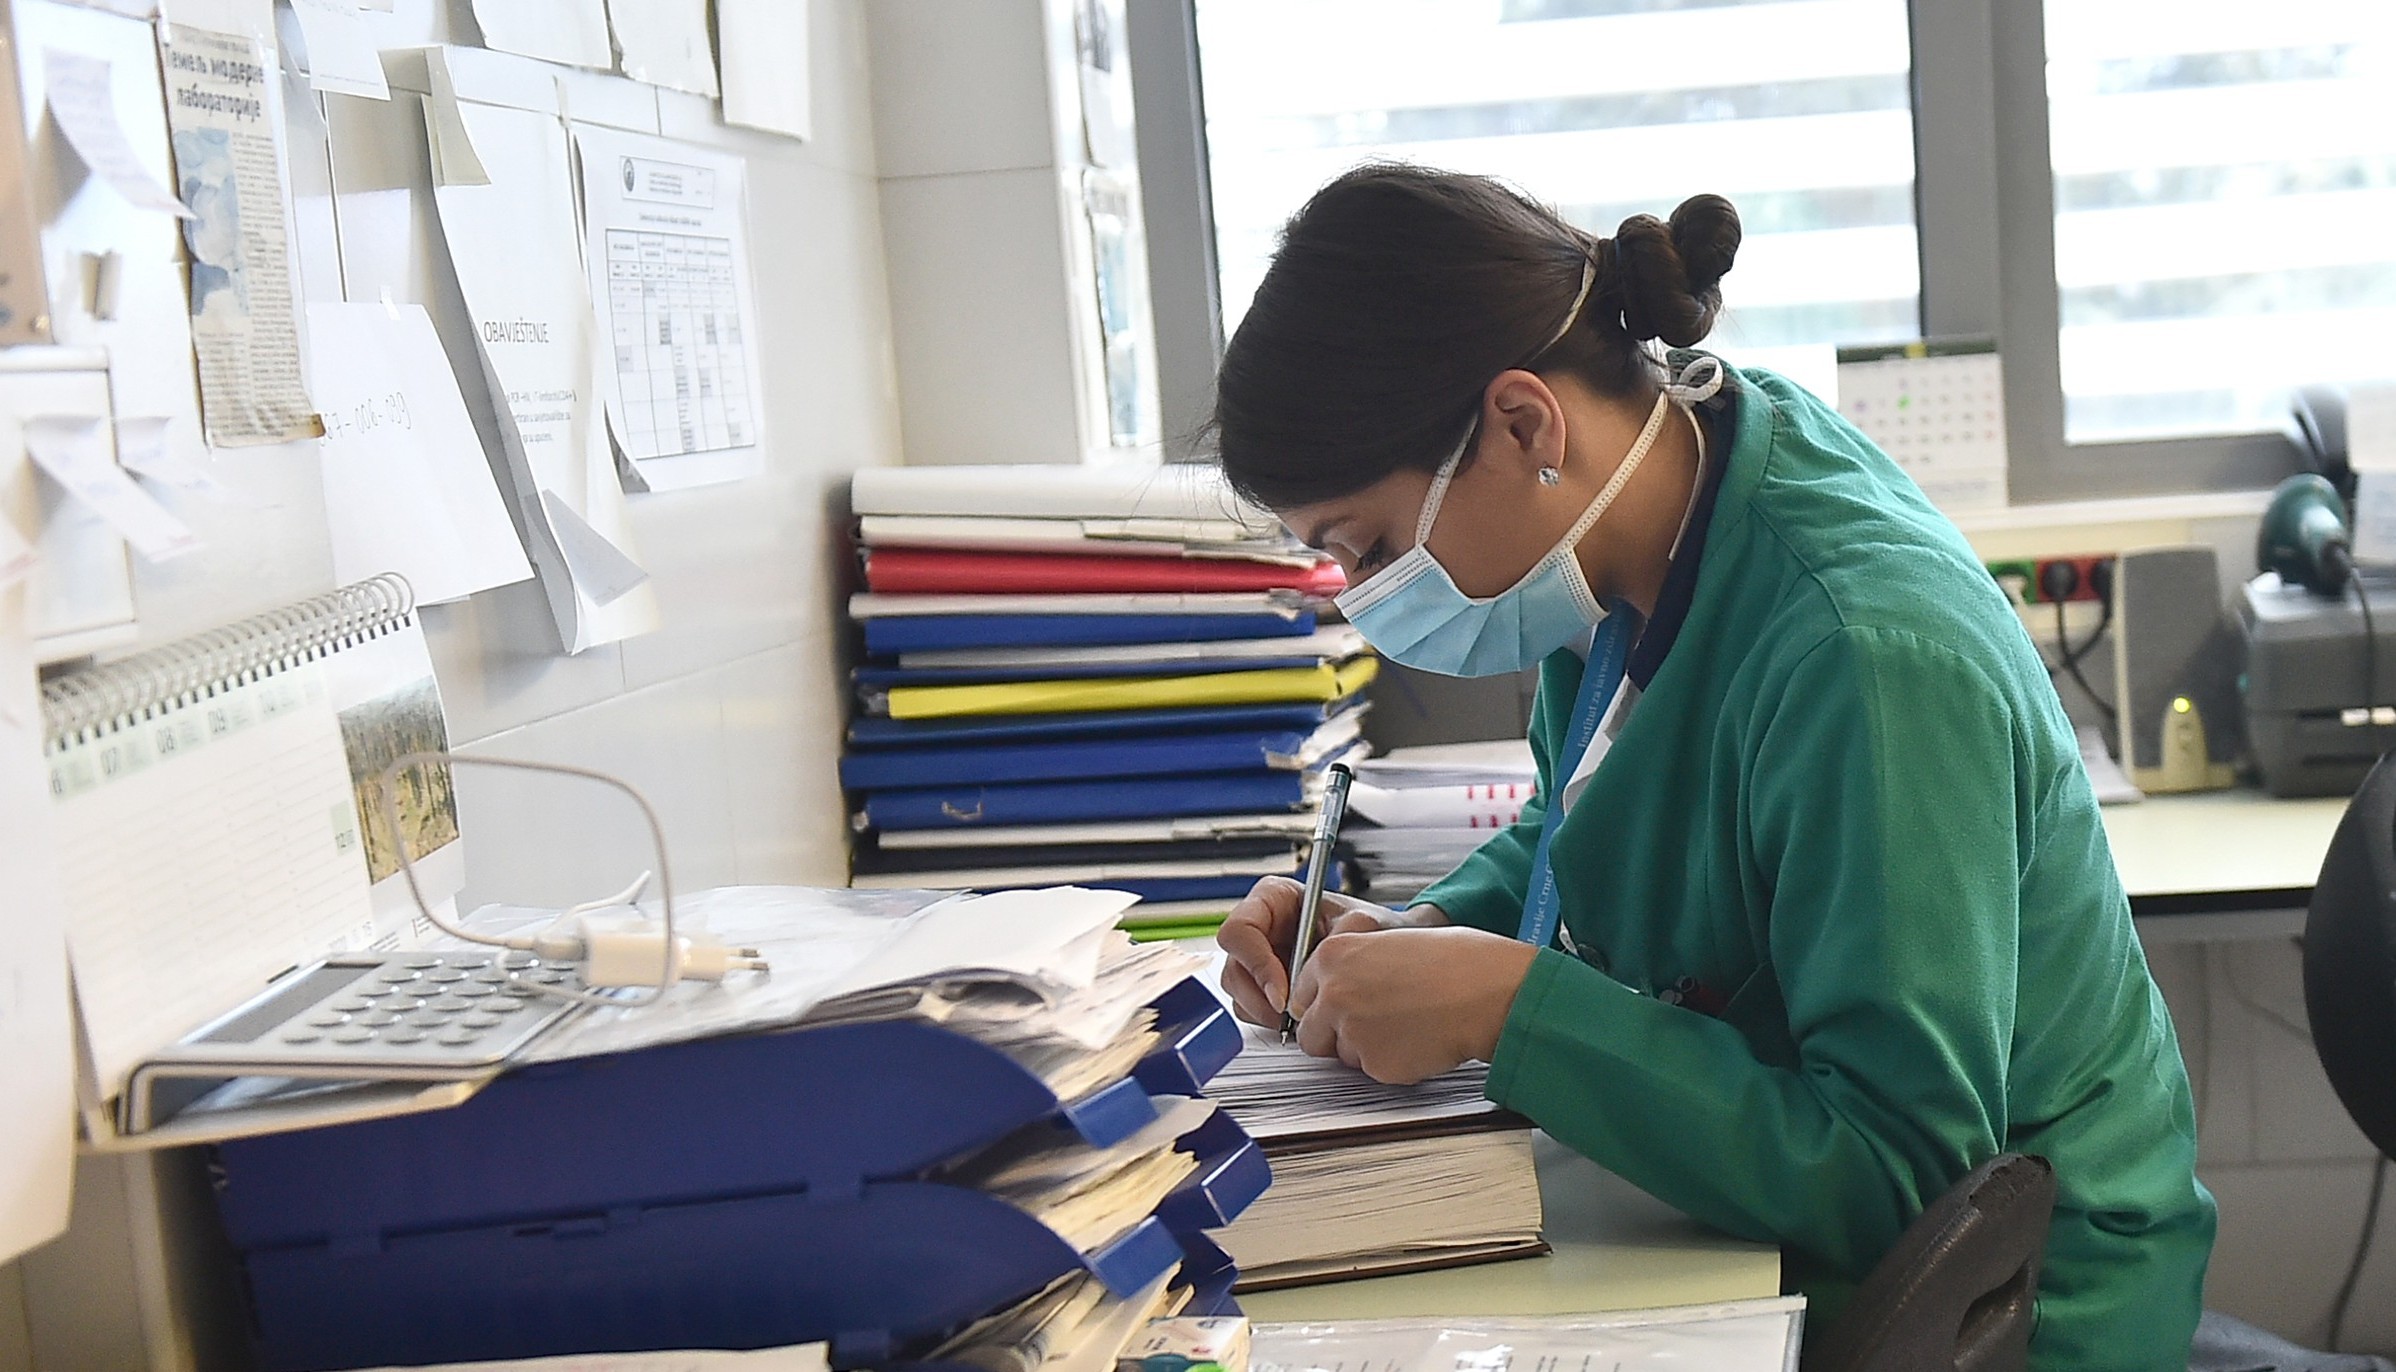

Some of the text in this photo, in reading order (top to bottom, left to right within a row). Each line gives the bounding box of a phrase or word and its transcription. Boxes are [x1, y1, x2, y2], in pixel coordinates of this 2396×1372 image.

[177, 82, 261, 123] лабораторије
[483, 316, 549, 343] OBAVJEŠTENJE
[1577, 705, 1599, 749] Institut
